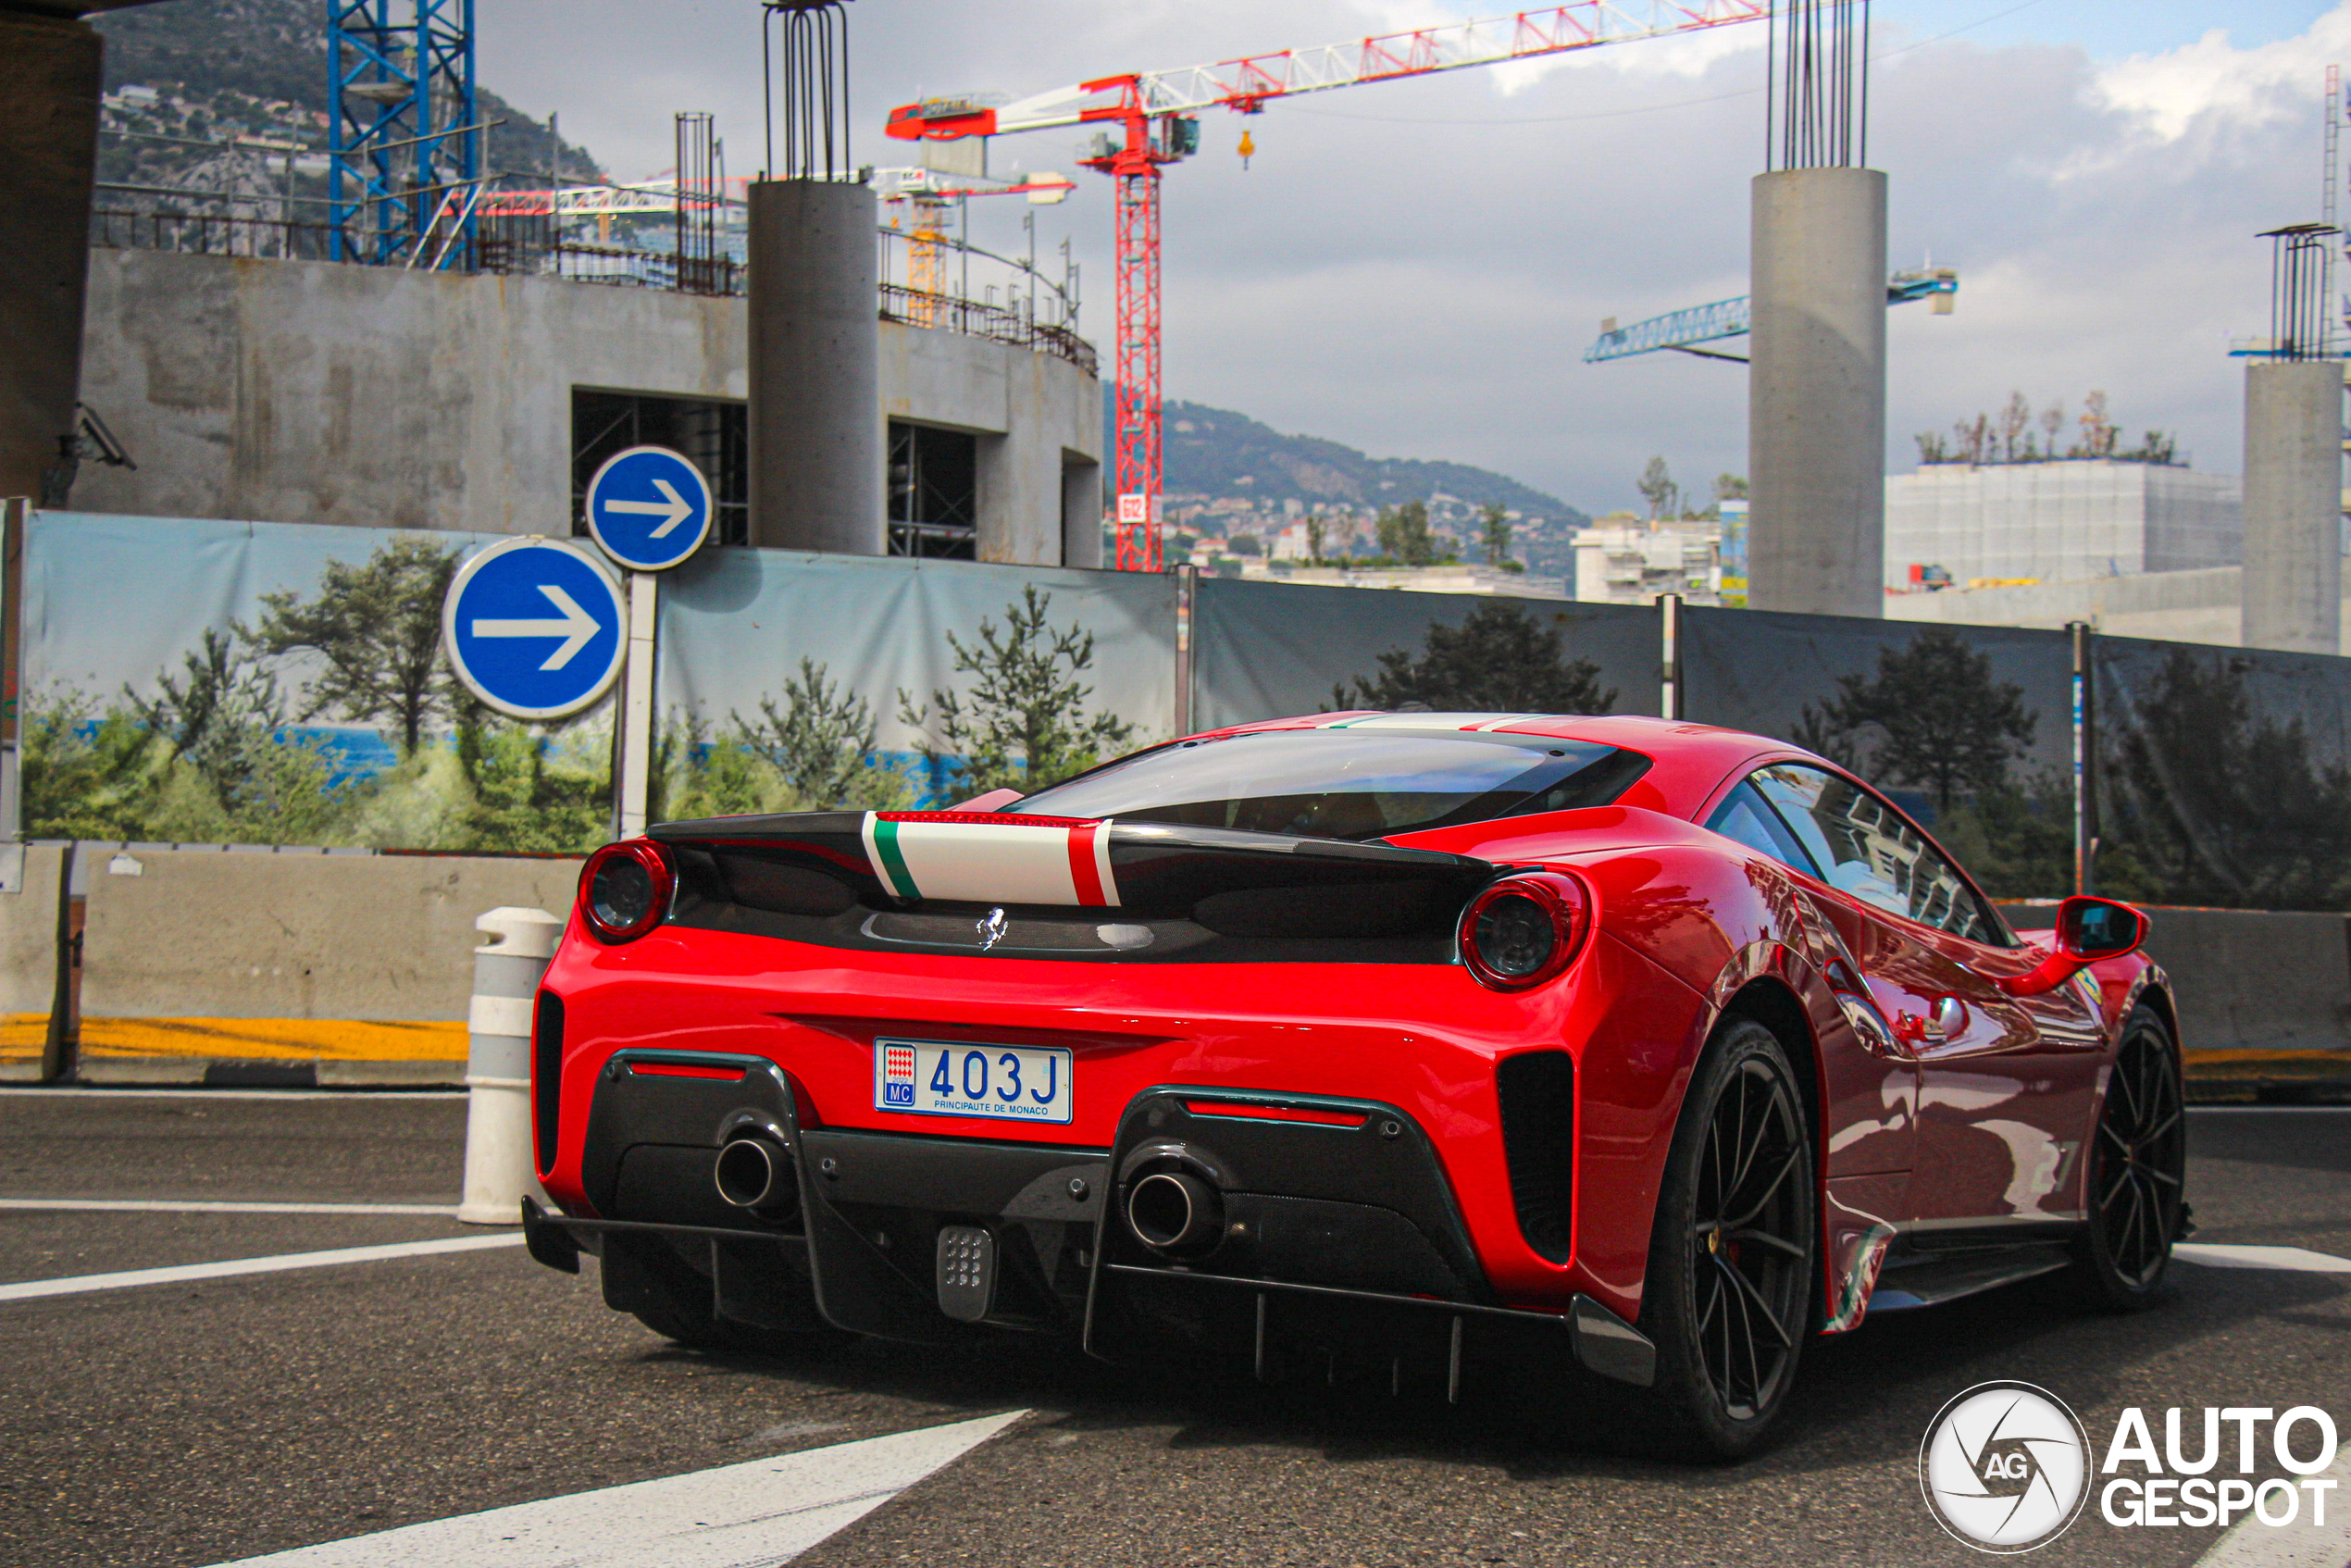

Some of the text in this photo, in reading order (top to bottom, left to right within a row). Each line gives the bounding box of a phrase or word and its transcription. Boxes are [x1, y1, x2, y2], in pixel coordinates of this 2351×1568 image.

[930, 1050, 1056, 1104] 403J
[890, 1085, 910, 1101] MC
[934, 1100, 1049, 1115] PRINCIPAUTE DE MONACO
